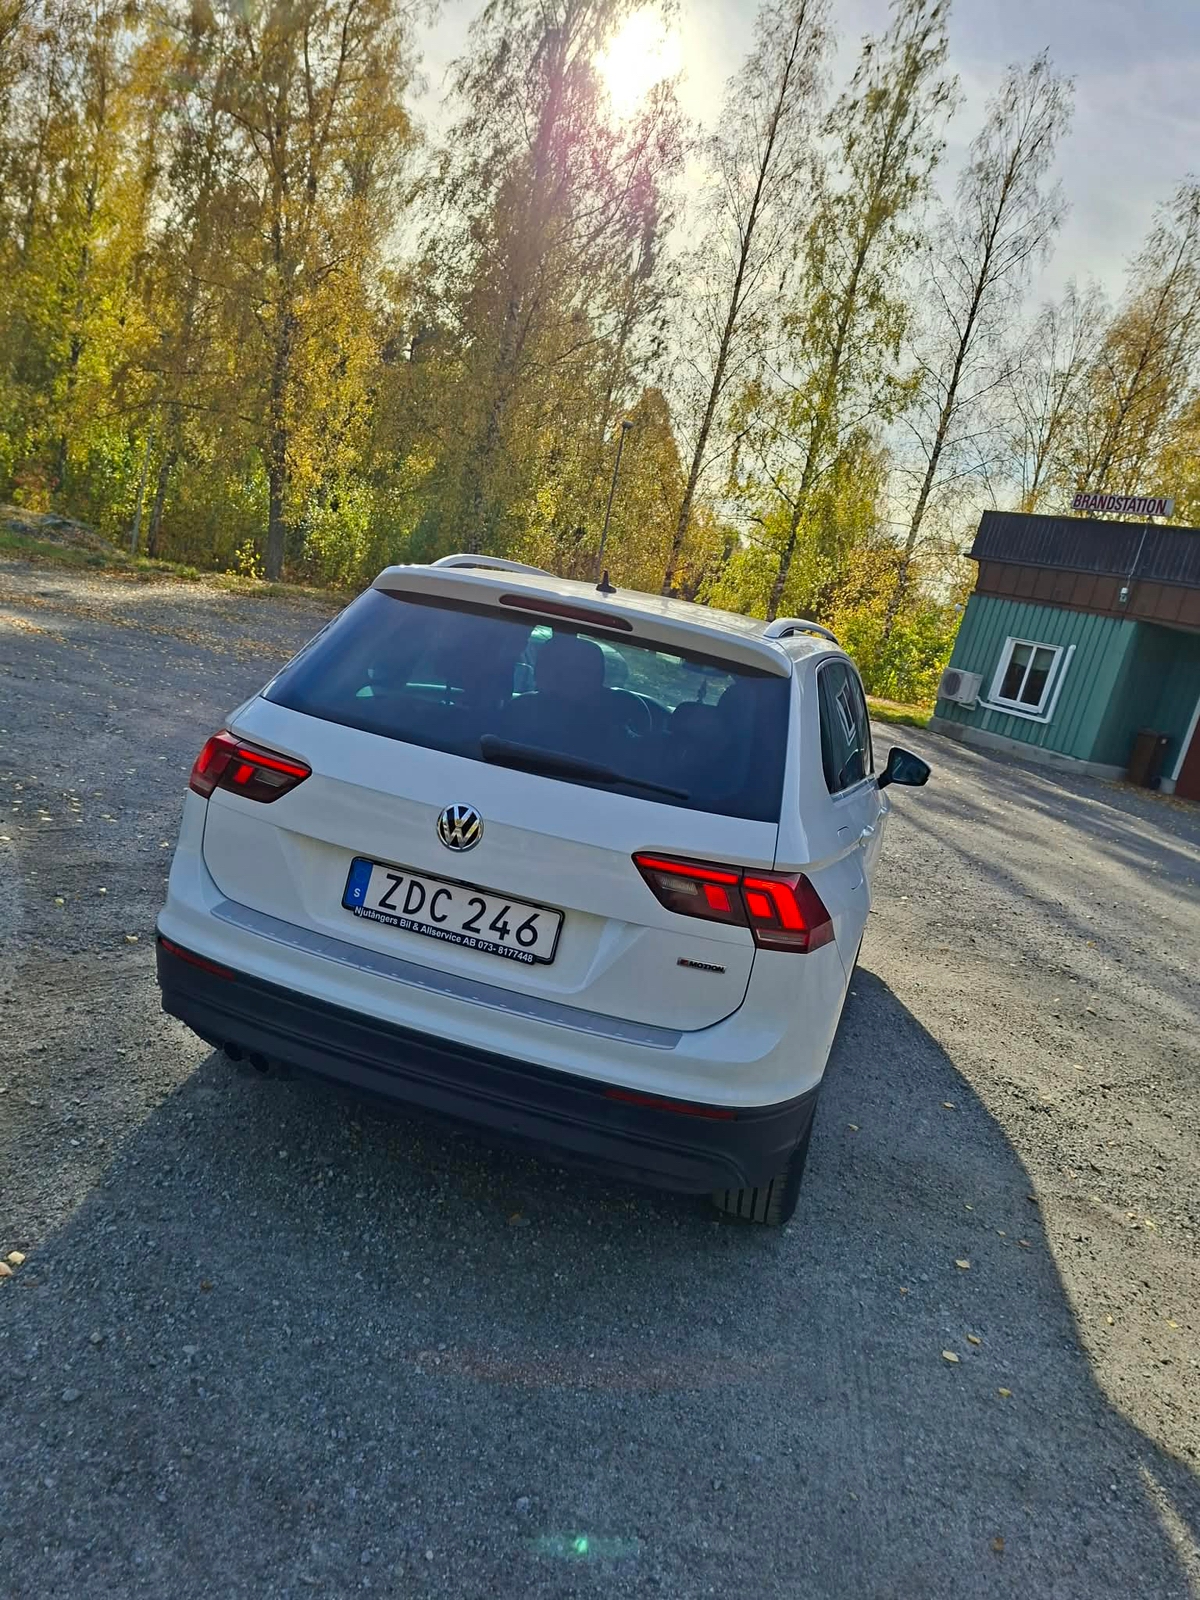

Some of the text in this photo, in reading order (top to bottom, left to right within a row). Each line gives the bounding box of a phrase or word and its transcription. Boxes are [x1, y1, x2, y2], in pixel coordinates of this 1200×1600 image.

[1073, 494, 1168, 515] BRANDSTATION
[353, 888, 361, 898] S
[378, 873, 541, 947] ZDC 246
[354, 905, 534, 963] Njutångers Bil & Allservice AB 073- 8177448
